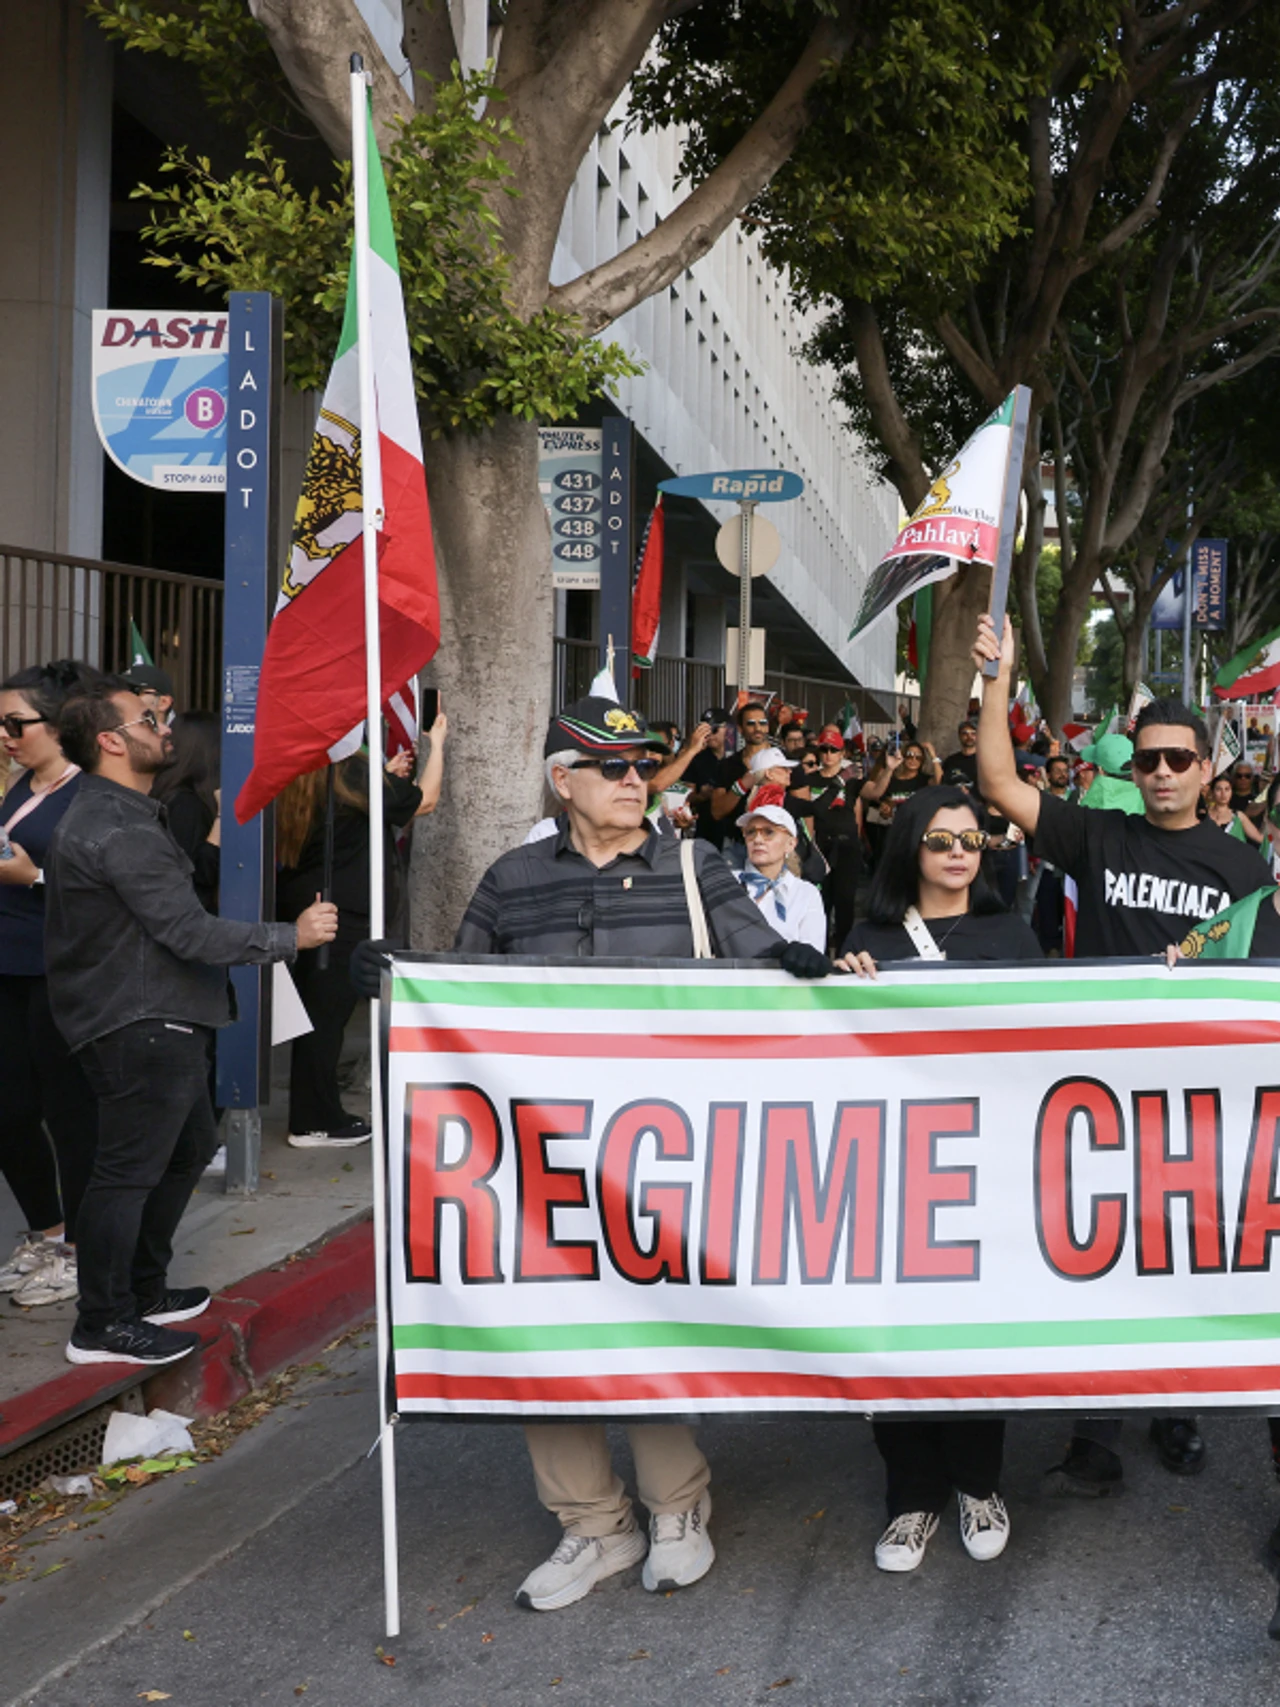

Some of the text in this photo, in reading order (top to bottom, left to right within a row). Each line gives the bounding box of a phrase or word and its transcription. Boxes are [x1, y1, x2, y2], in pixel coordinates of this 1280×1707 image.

[101, 317, 228, 349] DASH
[198, 396, 214, 422] B
[236, 331, 258, 510] LADOT
[163, 474, 225, 484] STOP# 6010
[560, 474, 593, 488] 431
[712, 473, 785, 498] Rapid
[560, 497, 595, 512] 437
[607, 442, 623, 554] LADOT
[560, 521, 595, 535] 438
[898, 520, 980, 548] Pahlavi
[560, 544, 595, 559] 448
[1197, 546, 1209, 576] MISS
[1209, 549, 1222, 605] MOMENT
[404, 1082, 981, 1286] REGIME
